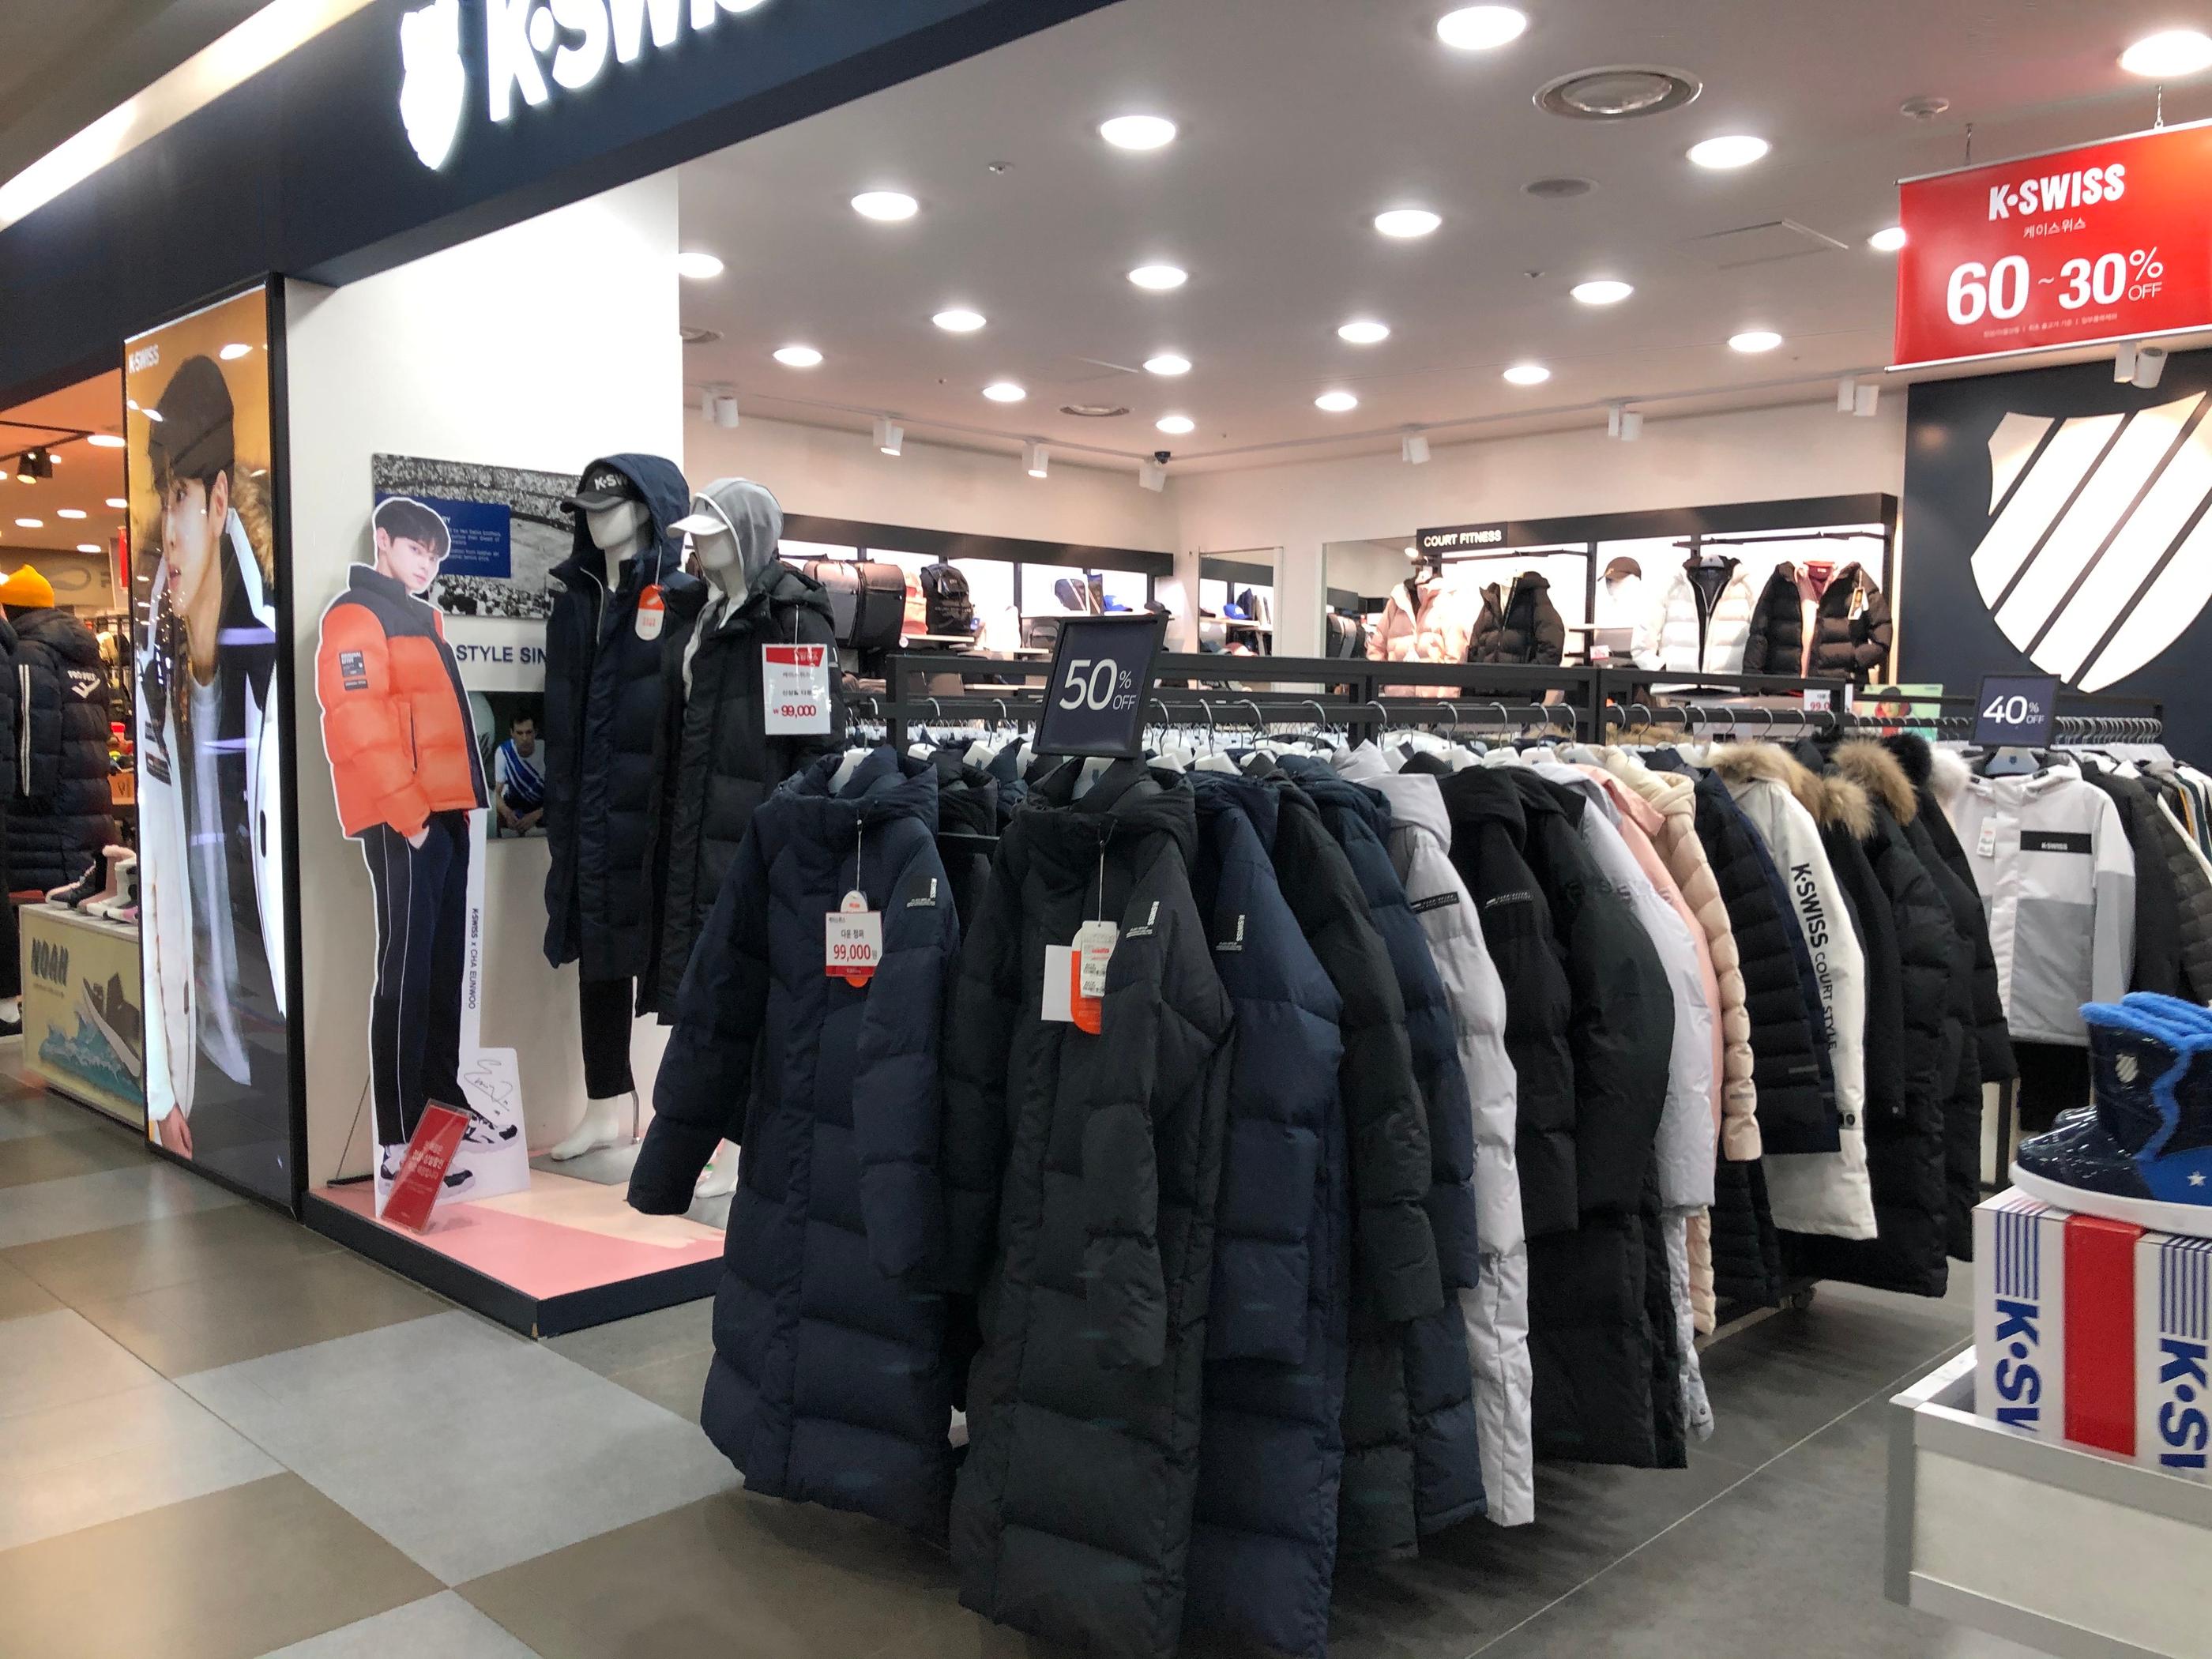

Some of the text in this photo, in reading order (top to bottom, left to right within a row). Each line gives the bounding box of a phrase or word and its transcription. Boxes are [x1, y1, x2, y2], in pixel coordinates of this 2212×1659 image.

[2023, 217, 2086, 239] 케이스위스
[1947, 254, 2030, 325] 60
[2128, 282, 2163, 302] OFF
[1424, 530, 1502, 547] COURT FITNESS
[456, 645, 514, 662] STYLE
[1112, 694, 1137, 710] OFF
[781, 705, 817, 718] 99,000
[2026, 715, 2045, 724] OFF
[841, 929, 852, 939] 다운
[833, 944, 871, 962] 99,000
[1815, 951, 1833, 1001] COURT
[468, 970, 477, 1010] EUNWOO
[1823, 1005, 1838, 1050] STYLE
